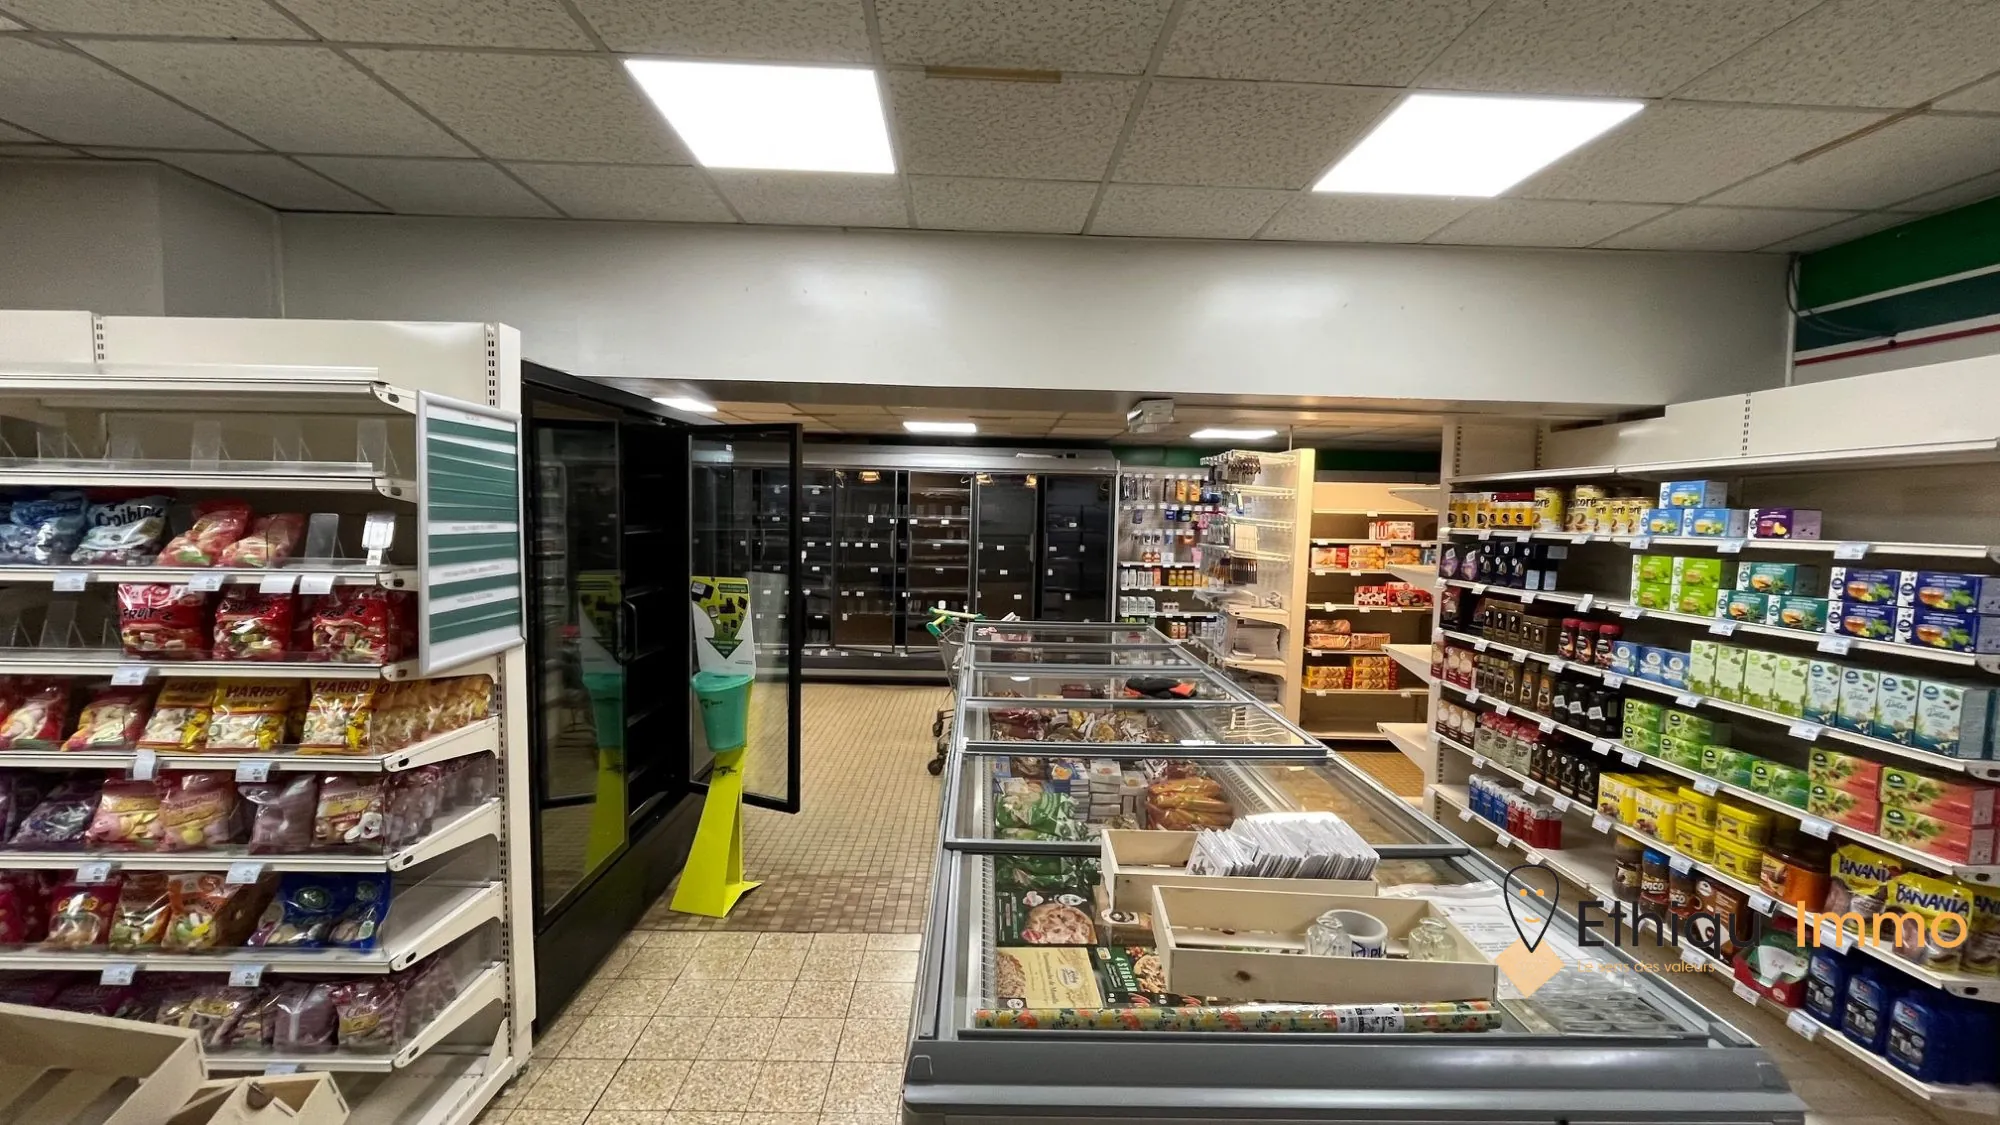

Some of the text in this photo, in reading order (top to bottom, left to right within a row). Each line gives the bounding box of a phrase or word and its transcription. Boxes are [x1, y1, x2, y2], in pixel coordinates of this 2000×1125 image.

[225, 685, 289, 697] HARIBO
[314, 680, 371, 693] HARIBO
[1896, 883, 1969, 913] BANANIA
